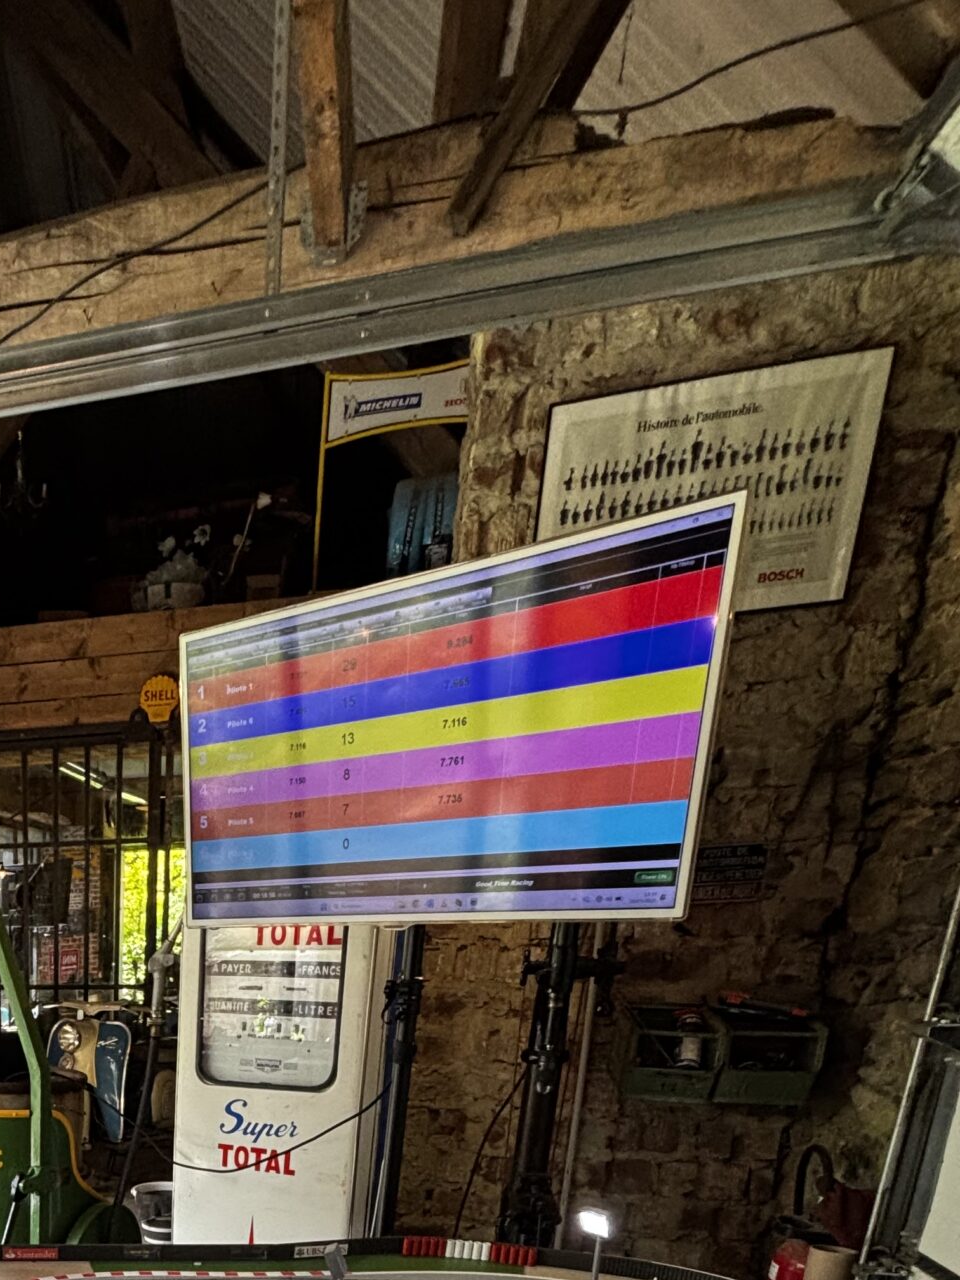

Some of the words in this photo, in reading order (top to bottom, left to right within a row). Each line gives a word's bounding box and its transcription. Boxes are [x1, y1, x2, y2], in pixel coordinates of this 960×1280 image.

[359, 396, 419, 412] MICHELIN
[637, 415, 680, 432] Histoire
[681, 413, 695, 427] de
[757, 567, 805, 585] BOSCH
[144, 689, 176, 702] SHELL
[197, 685, 205, 700] 1
[198, 719, 207, 733] 2
[442, 716, 467, 729] 7.116
[341, 731, 355, 745] 13
[440, 756, 465, 768] 7.761
[343, 768, 351, 781] 8
[199, 783, 208, 796] 4
[342, 804, 350, 815] 7
[199, 815, 208, 829] 5
[342, 838, 350, 850] 0
[256, 924, 343, 946] TOTAL
[221, 963, 252, 974] PAYER
[301, 965, 341, 976] FRANCS
[219, 1098, 299, 1143] Super
[218, 1143, 296, 1176] TOTAL
[16, 1249, 57, 1259] Santander
